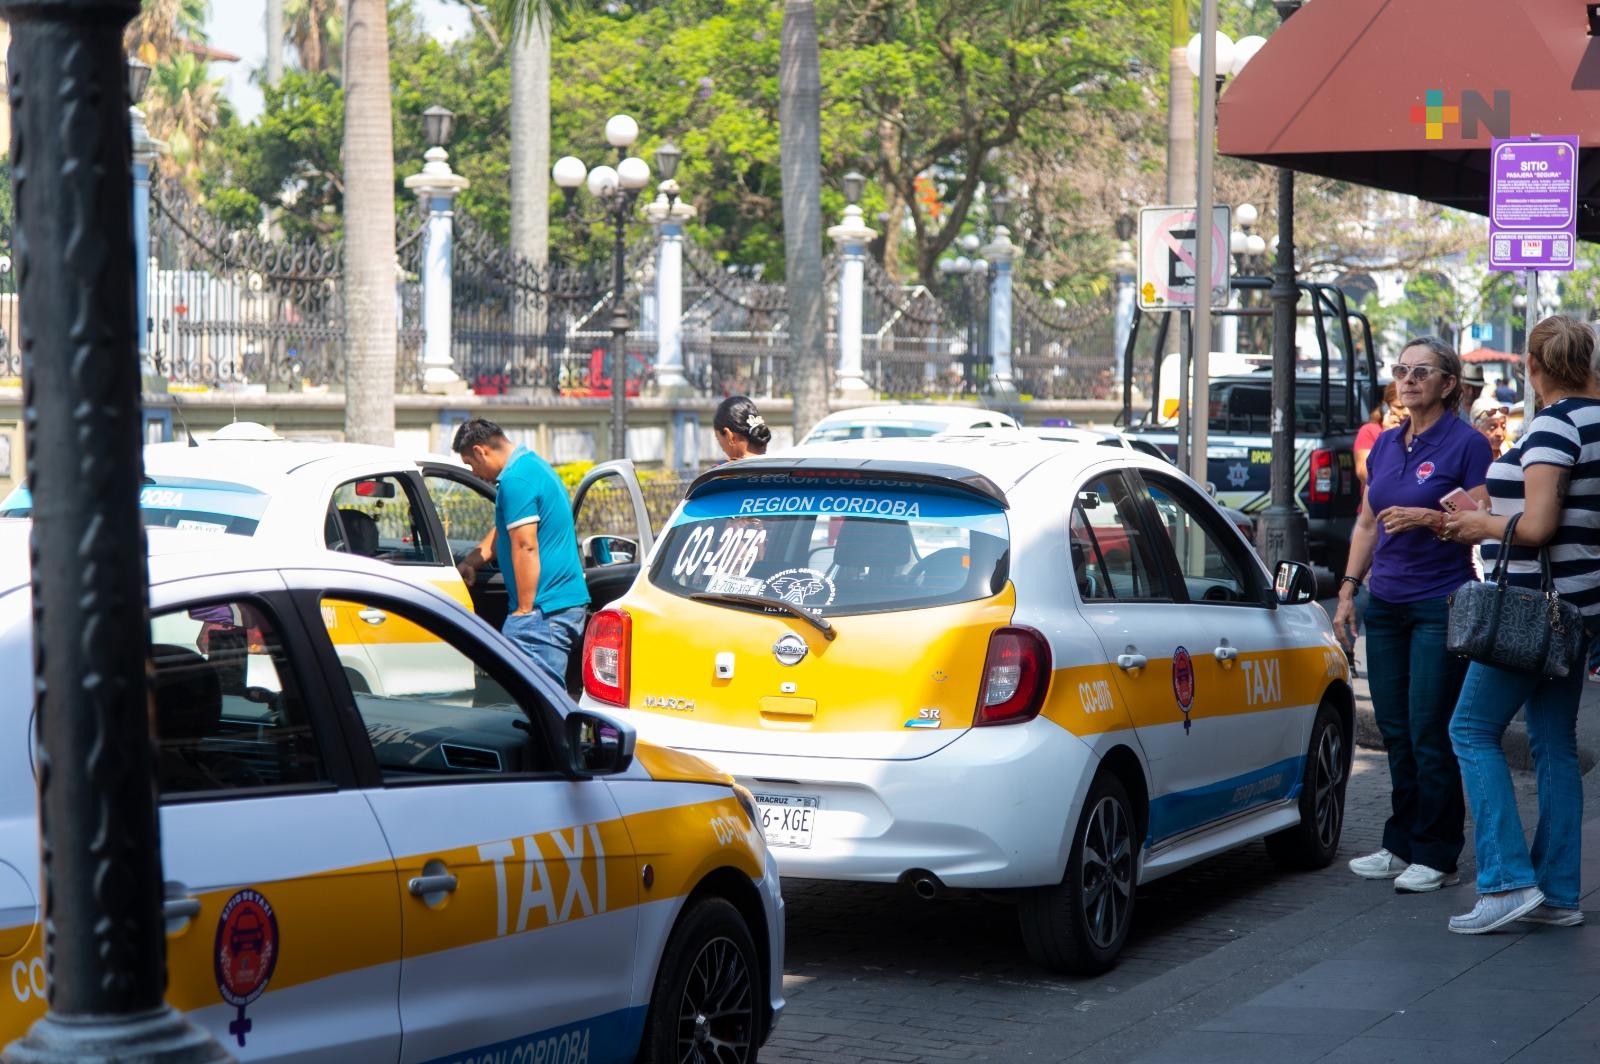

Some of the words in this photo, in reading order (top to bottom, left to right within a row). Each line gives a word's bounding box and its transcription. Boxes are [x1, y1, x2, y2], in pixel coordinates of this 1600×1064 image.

[1520, 161, 1548, 171] SITIO
[739, 496, 815, 514] REGION
[819, 496, 920, 518] CORDOBA
[674, 526, 768, 578] CO-2076
[765, 568, 797, 585] HOSPITAL
[1240, 658, 1281, 705] TAXI
[646, 696, 695, 711] MARCH
[919, 708, 940, 719] SR
[758, 807, 811, 832] 6-XGE
[476, 823, 606, 937] TAXI
[222, 893, 242, 922] SITIO
[242, 890, 254, 901] DE
[255, 893, 272, 917] TAXI
